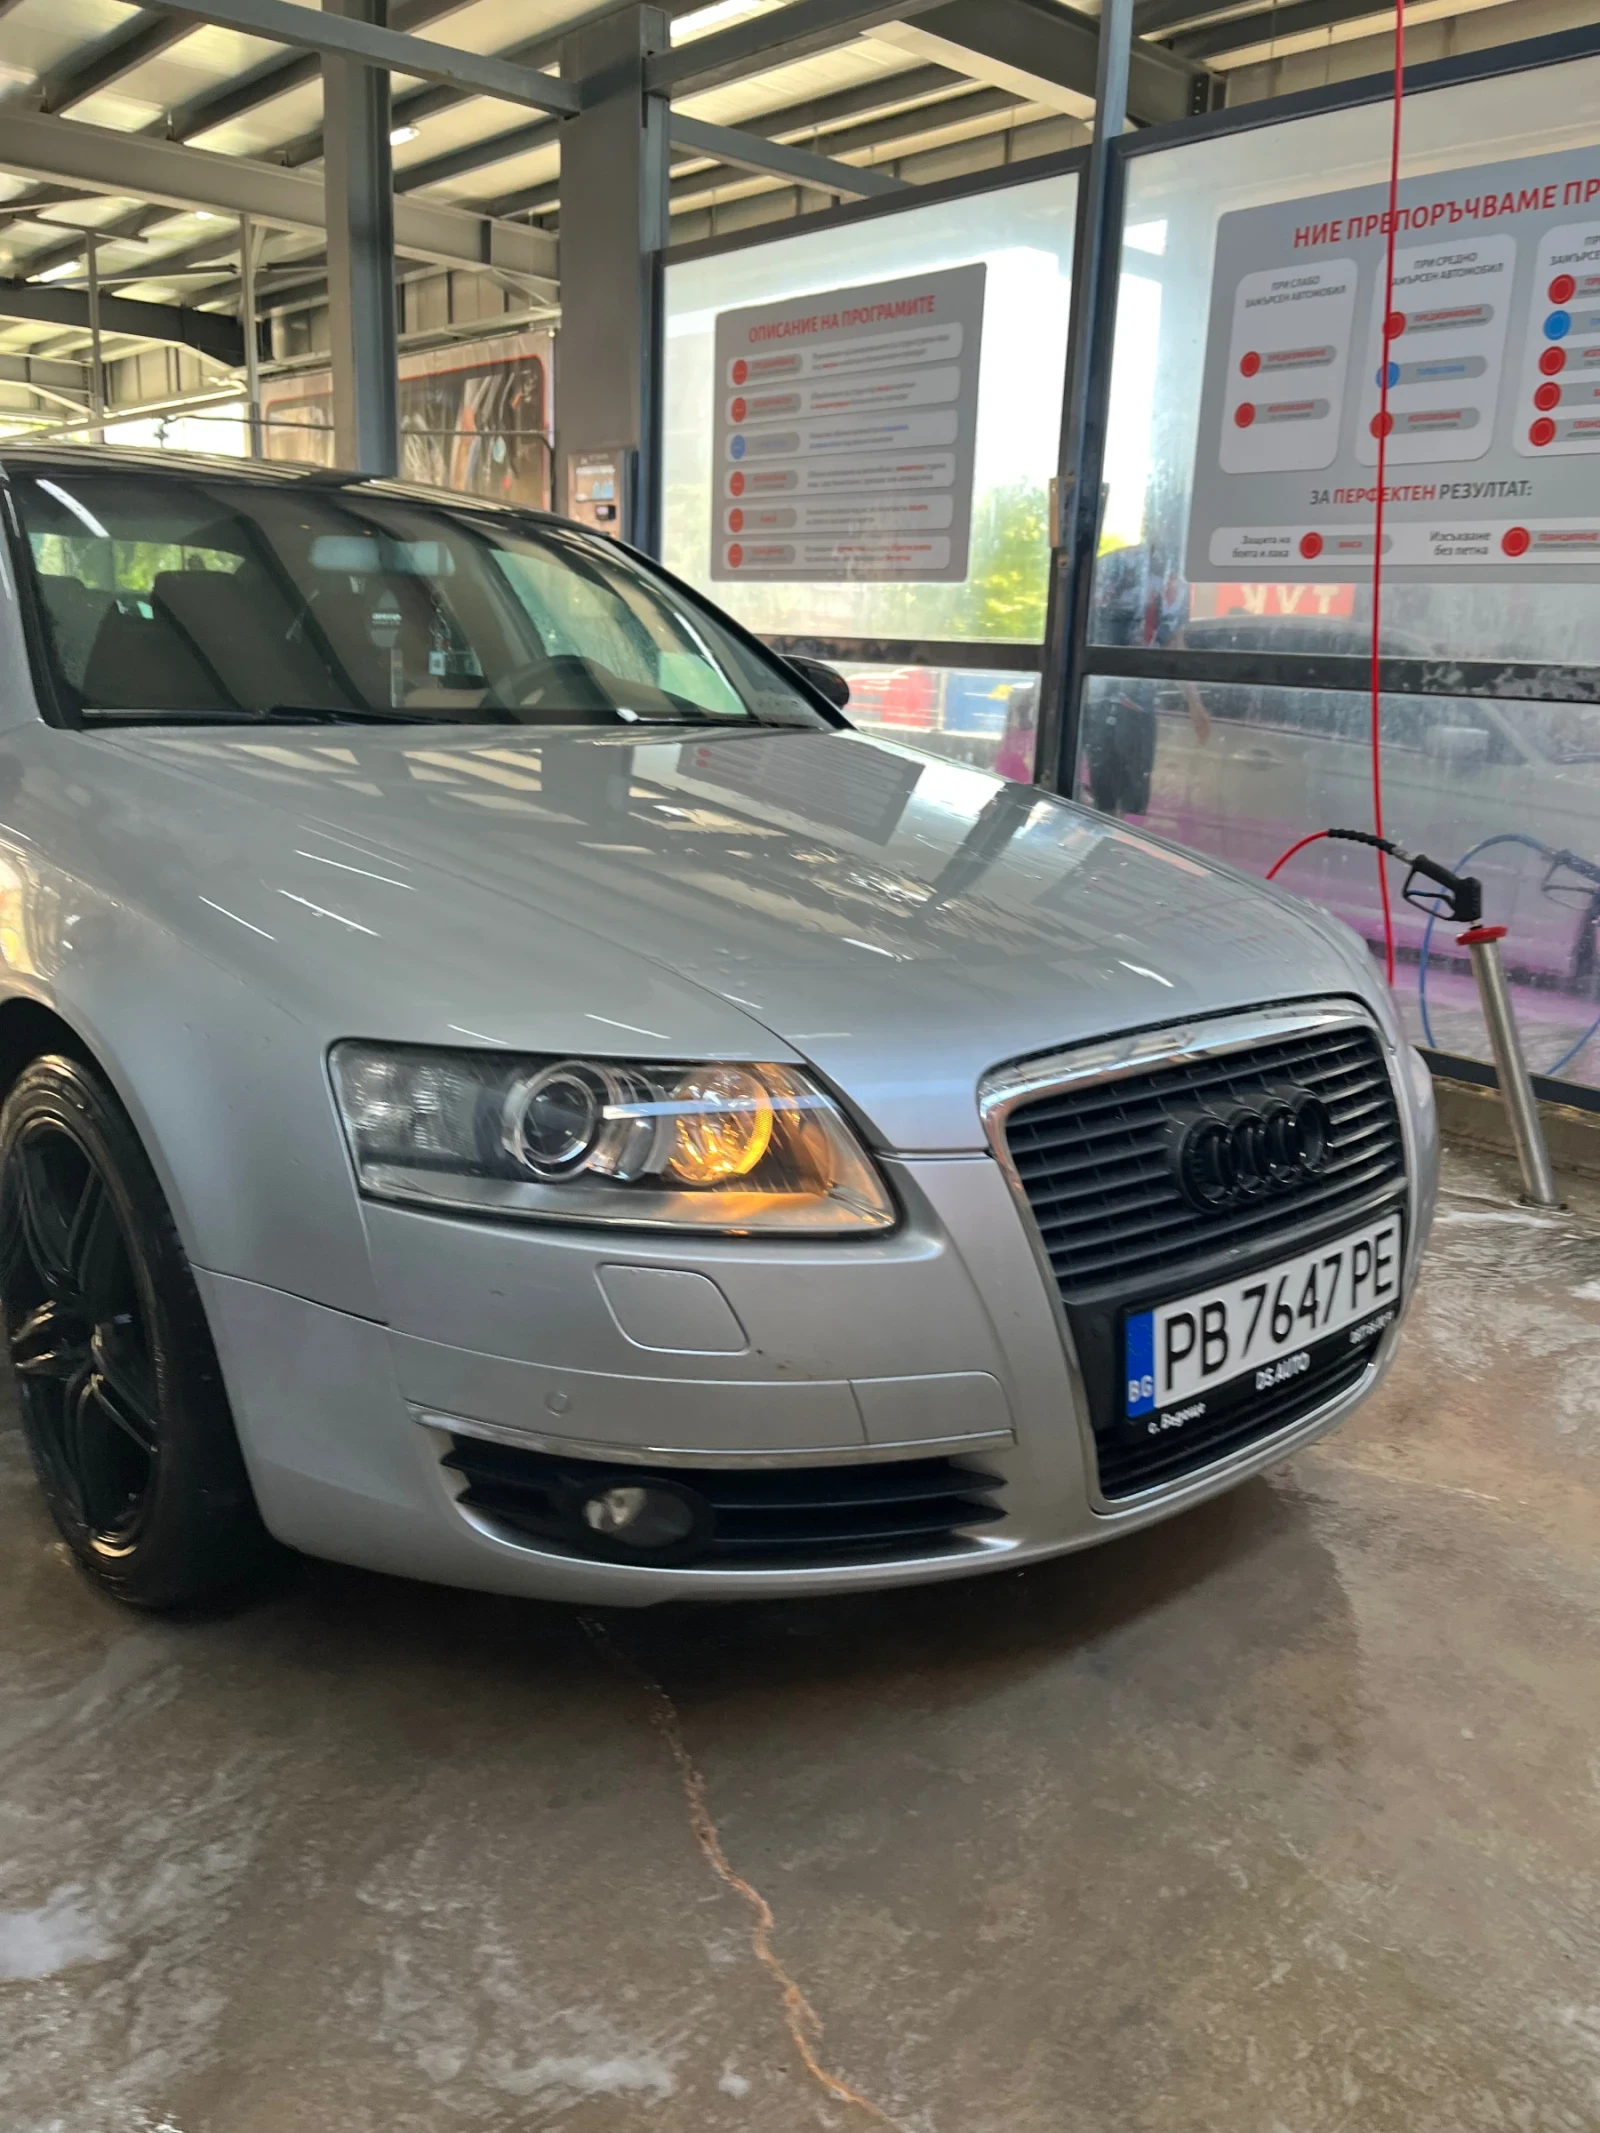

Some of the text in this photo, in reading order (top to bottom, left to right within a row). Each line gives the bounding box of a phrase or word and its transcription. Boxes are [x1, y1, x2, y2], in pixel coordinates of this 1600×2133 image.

[1294, 220, 1343, 248] НИЕ
[1347, 184, 1558, 240] ПРЕПОРЪЧВАМЕ
[748, 295, 936, 343] ОПИСАНИЕ НА ПРОГРАМИТЕ
[1310, 489, 1331, 505] ЗА
[1439, 480, 1534, 500] РЕЗУЛТАТ:
[1164, 1227, 1394, 1393] PB 7647 PE
[1128, 1375, 1154, 1403] BG
